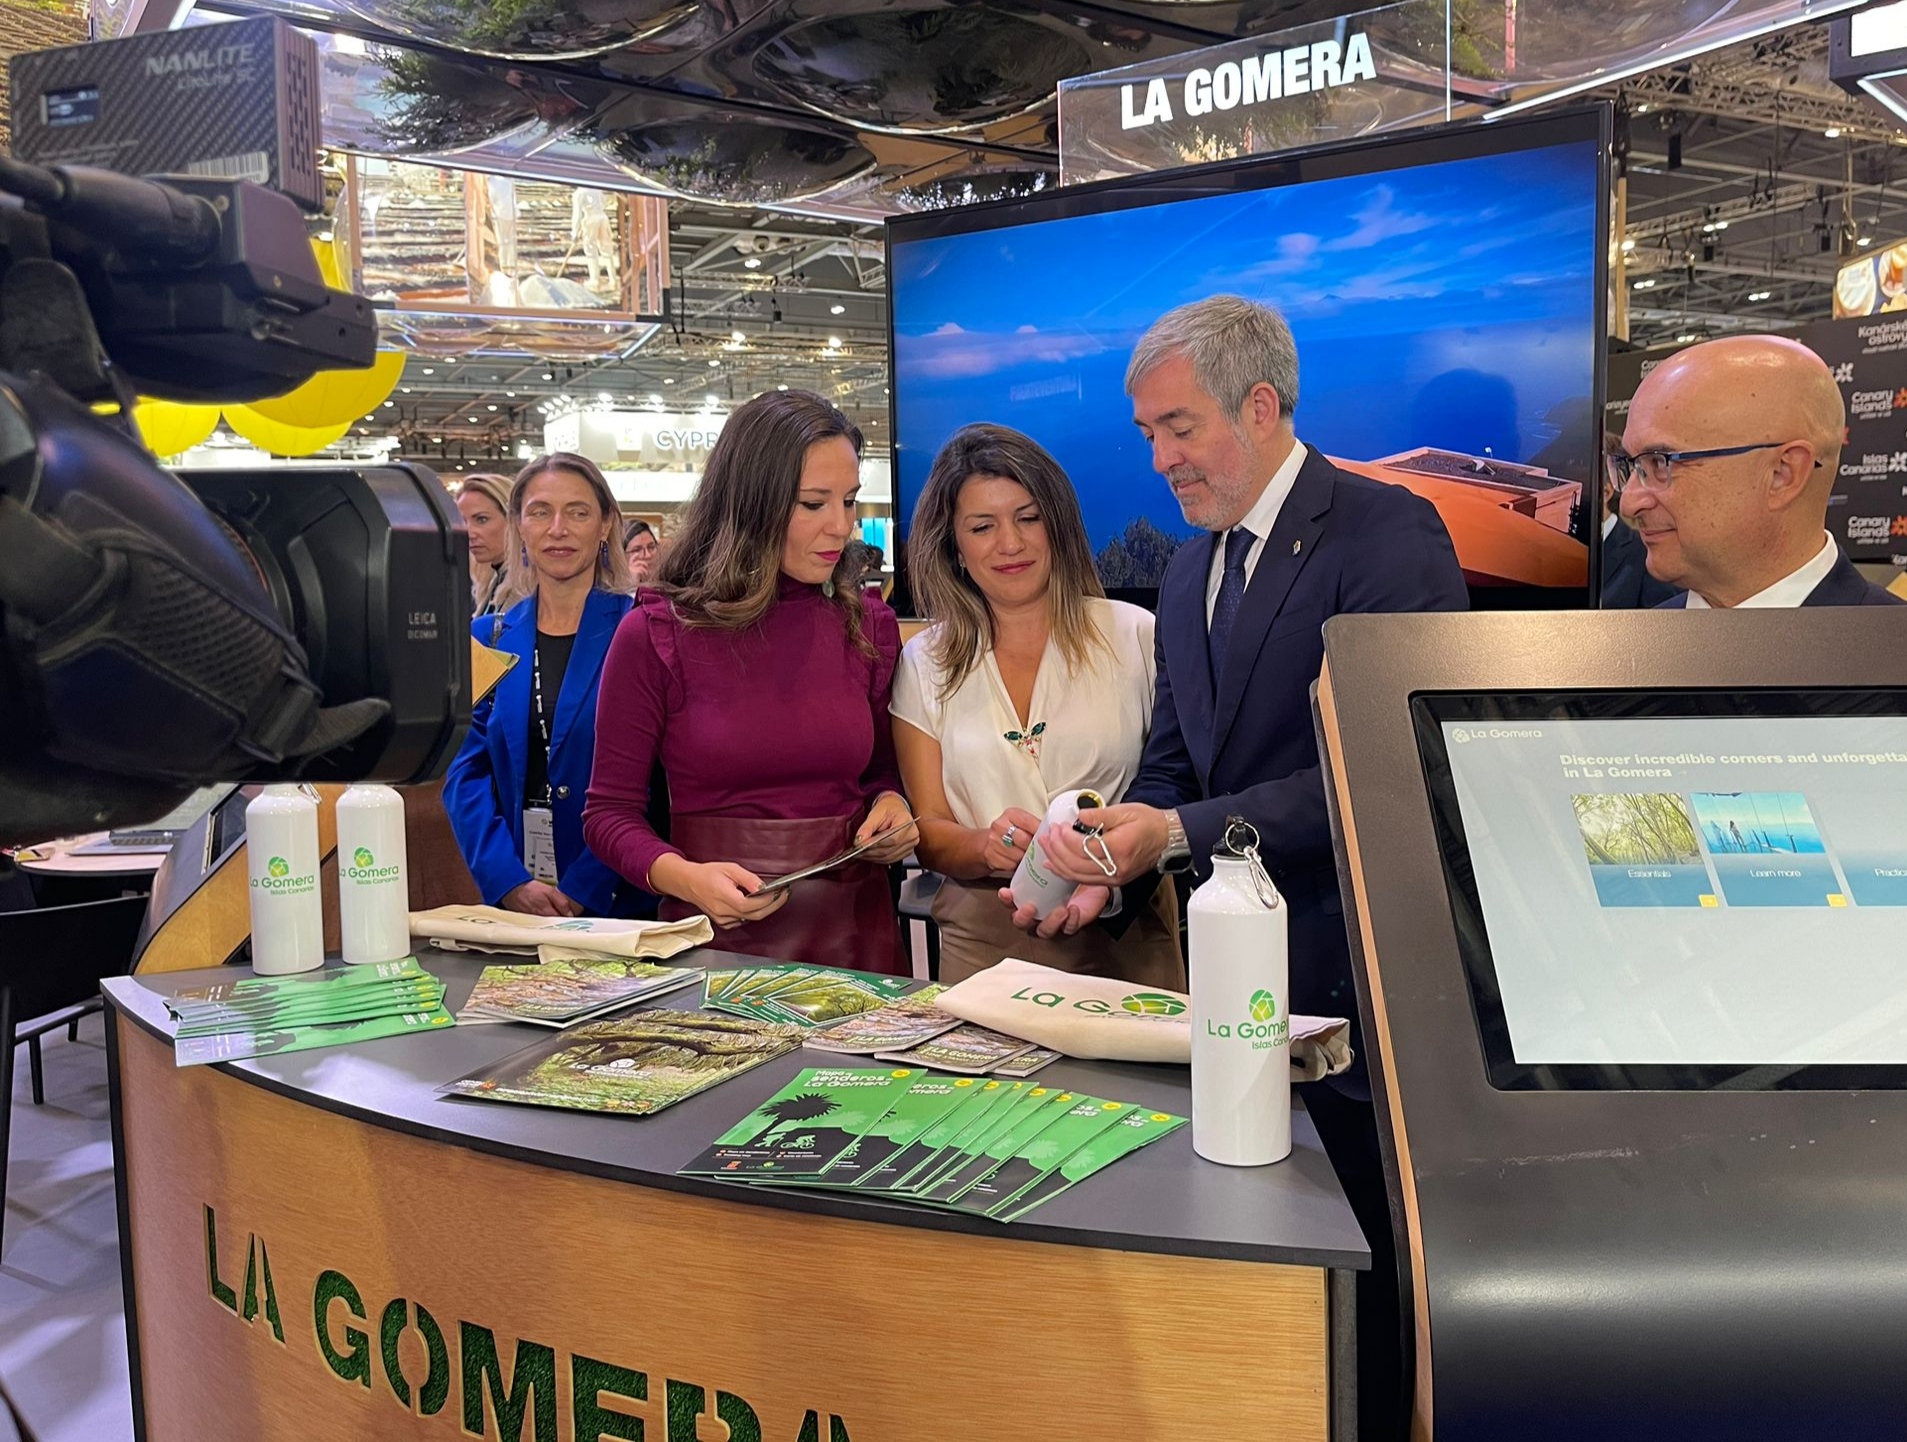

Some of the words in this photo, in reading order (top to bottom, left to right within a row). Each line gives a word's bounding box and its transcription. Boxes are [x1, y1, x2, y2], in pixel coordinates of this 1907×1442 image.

[145, 42, 256, 76] NANLITE
[1121, 78, 1173, 130] LA
[1184, 32, 1377, 117] GOMERA
[1851, 390, 1893, 402] Canary
[1851, 401, 1893, 414] Islands
[1862, 453, 1888, 464] Islas
[1840, 464, 1888, 476] Canarias
[1848, 515, 1890, 528] Canary
[1848, 527, 1890, 538] Islands
[408, 612, 436, 625] LEICA
[1470, 729, 1486, 739] La
[1489, 728, 1543, 739] Gomera
[1559, 754, 1632, 766] Discover
[1634, 753, 1716, 766] incredible
[1719, 754, 1784, 765] corners
[1787, 753, 1818, 764] and
[1563, 767, 1580, 778] in
[1582, 767, 1604, 778] La
[1607, 767, 1673, 778] Gomera
[348, 865, 399, 879] Gomera
[1627, 868, 1672, 879] Essentials
[1777, 870, 1802, 878] more
[261, 874, 315, 888] Gomera
[1011, 987, 1066, 1008] La
[1207, 1018, 1231, 1039] La
[1251, 1040, 1272, 1050] Islas
[931, 1046, 948, 1055] LA
[948, 1050, 999, 1060] GOMERA
[810, 1074, 884, 1082] senderos
[203, 1203, 286, 1347] LA
